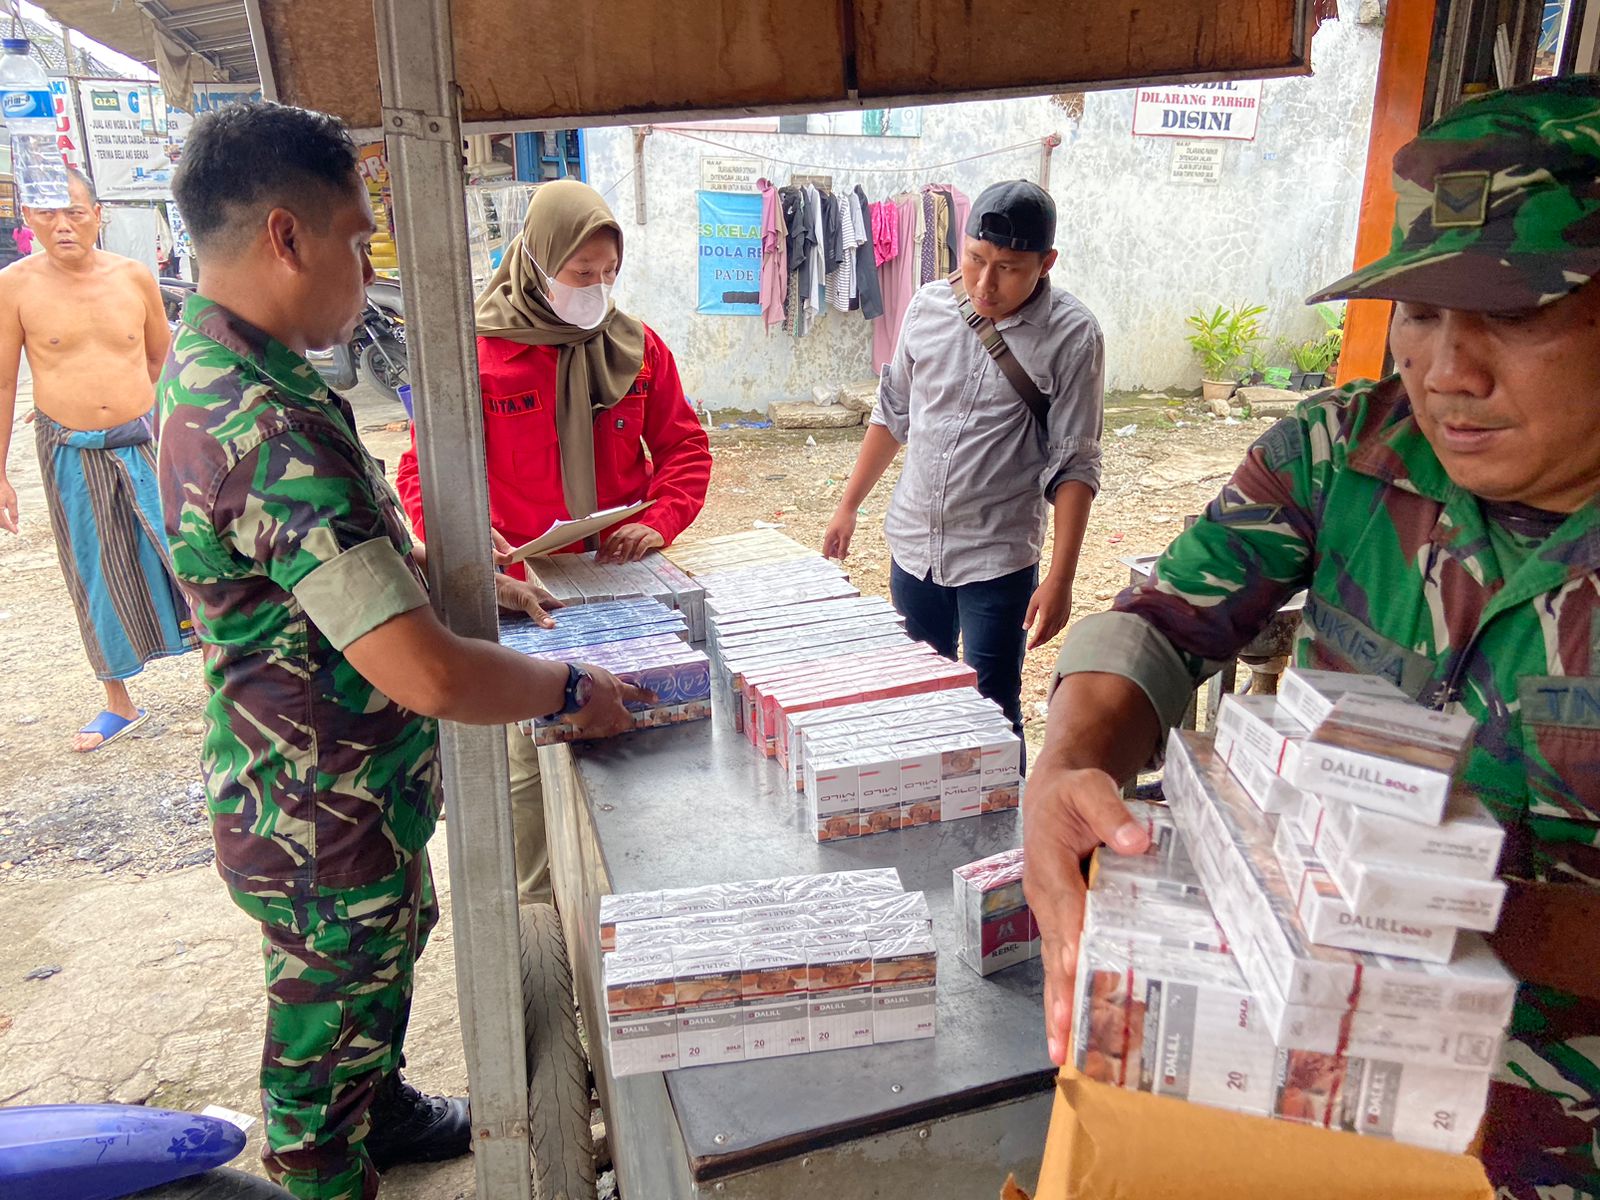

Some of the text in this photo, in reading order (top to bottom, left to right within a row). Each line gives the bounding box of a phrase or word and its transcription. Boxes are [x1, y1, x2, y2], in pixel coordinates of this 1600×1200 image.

[95, 97, 118, 106] GLB
[1141, 91, 1255, 108] DILARANG PARKIR
[1161, 109, 1232, 131] DISINI
[716, 224, 762, 239] KELA
[985, 765, 1017, 775] MILO
[1320, 758, 1383, 786] DALILL
[904, 779, 938, 789] MILO
[864, 785, 898, 796] MILO
[945, 786, 978, 796] MILO
[820, 791, 856, 801] MILO
[991, 943, 1020, 958] REBEL
[820, 1002, 846, 1011] DALILL
[754, 1009, 781, 1018] DALILL
[689, 1017, 716, 1025] DALILL
[622, 1025, 649, 1034] DALILL
[819, 1031, 830, 1040] 20
[754, 1039, 765, 1048] 20
[688, 1046, 700, 1056] 20
[1166, 1033, 1181, 1077] DALILL
[1227, 1071, 1243, 1090] 20
[1433, 1110, 1450, 1130] 20
